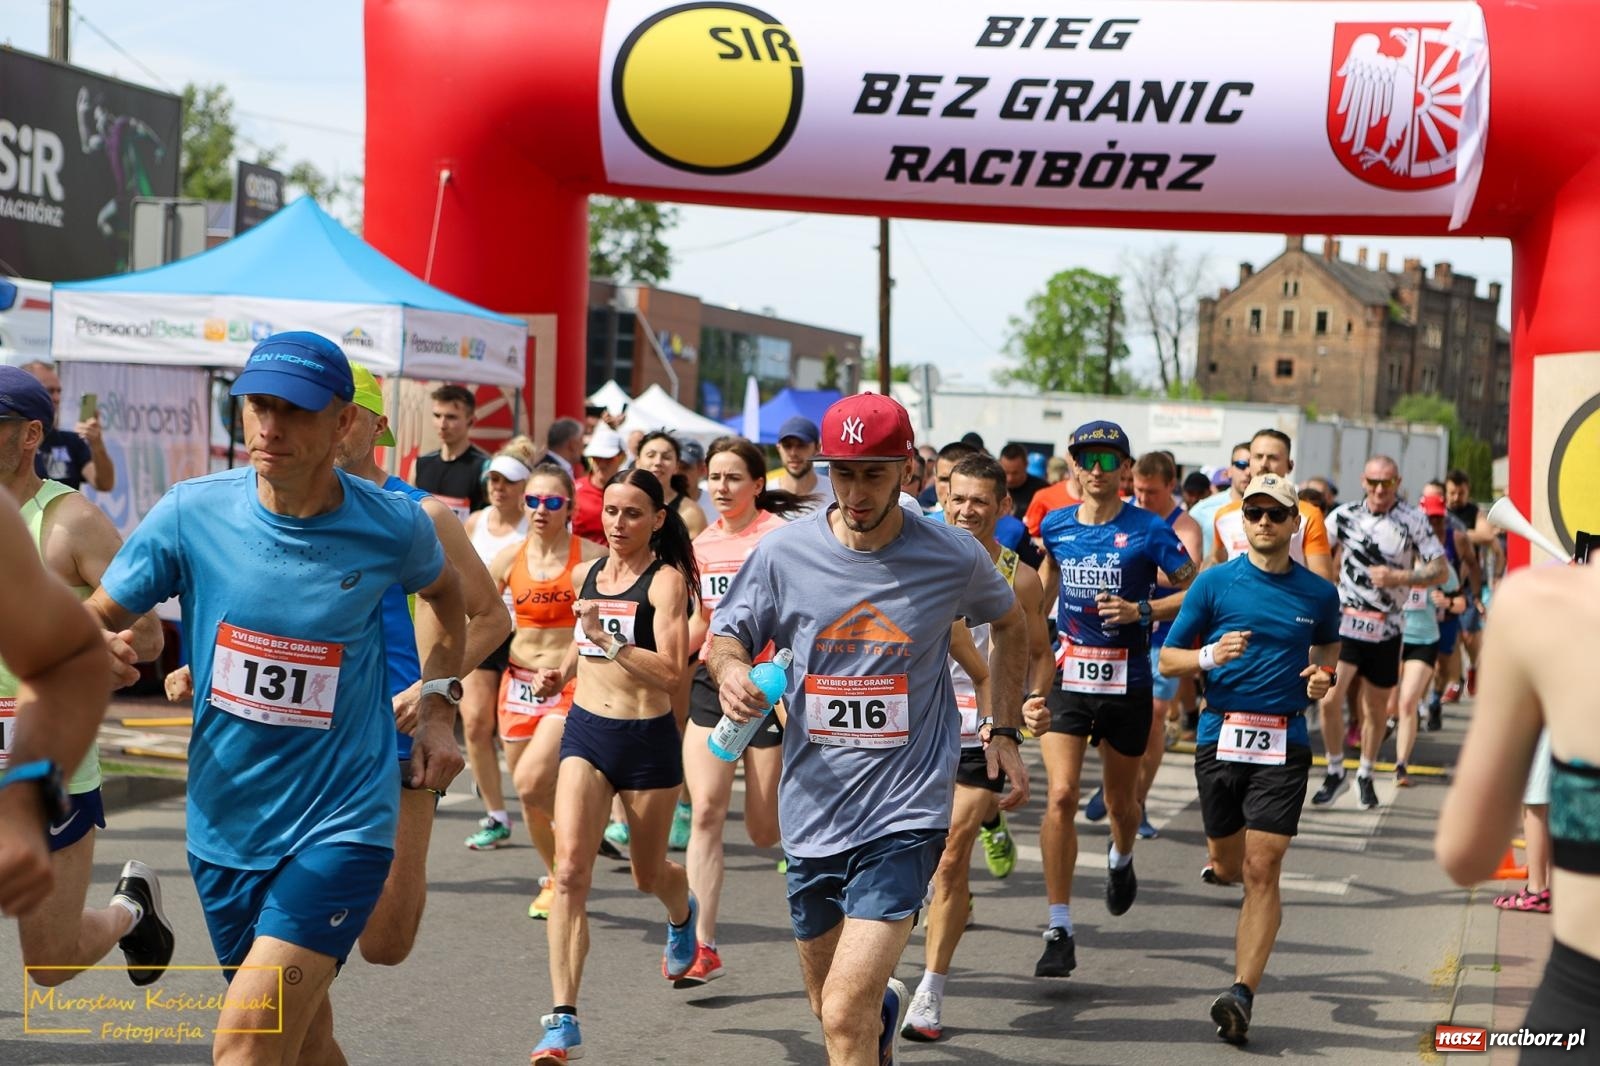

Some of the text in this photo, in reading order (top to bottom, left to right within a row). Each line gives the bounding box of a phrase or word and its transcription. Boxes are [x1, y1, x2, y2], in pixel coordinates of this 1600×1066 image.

[709, 27, 799, 62] SIR
[975, 16, 1140, 50] BIEG
[853, 73, 1254, 124] BEZ GRANIC
[885, 140, 1216, 191] RACIBÓRZ
[75, 315, 196, 338] PersonalBest
[250, 353, 324, 373] RUN HIGHER
[1062, 568, 1121, 586] SILESIAN
[531, 590, 571, 604] asics
[231, 629, 247, 641] XVI
[248, 634, 270, 646] BIEG
[270, 639, 290, 650] BEZ
[290, 643, 328, 654] GRANIC
[816, 643, 912, 657] NIKE TRAIL
[243, 659, 307, 705] 131
[830, 679, 848, 687] BIEG
[848, 679, 863, 687] BEZ
[864, 678, 895, 686] GRANIC
[1078, 662, 1114, 681] 199
[827, 699, 887, 729] 216
[1234, 729, 1271, 750] 173
